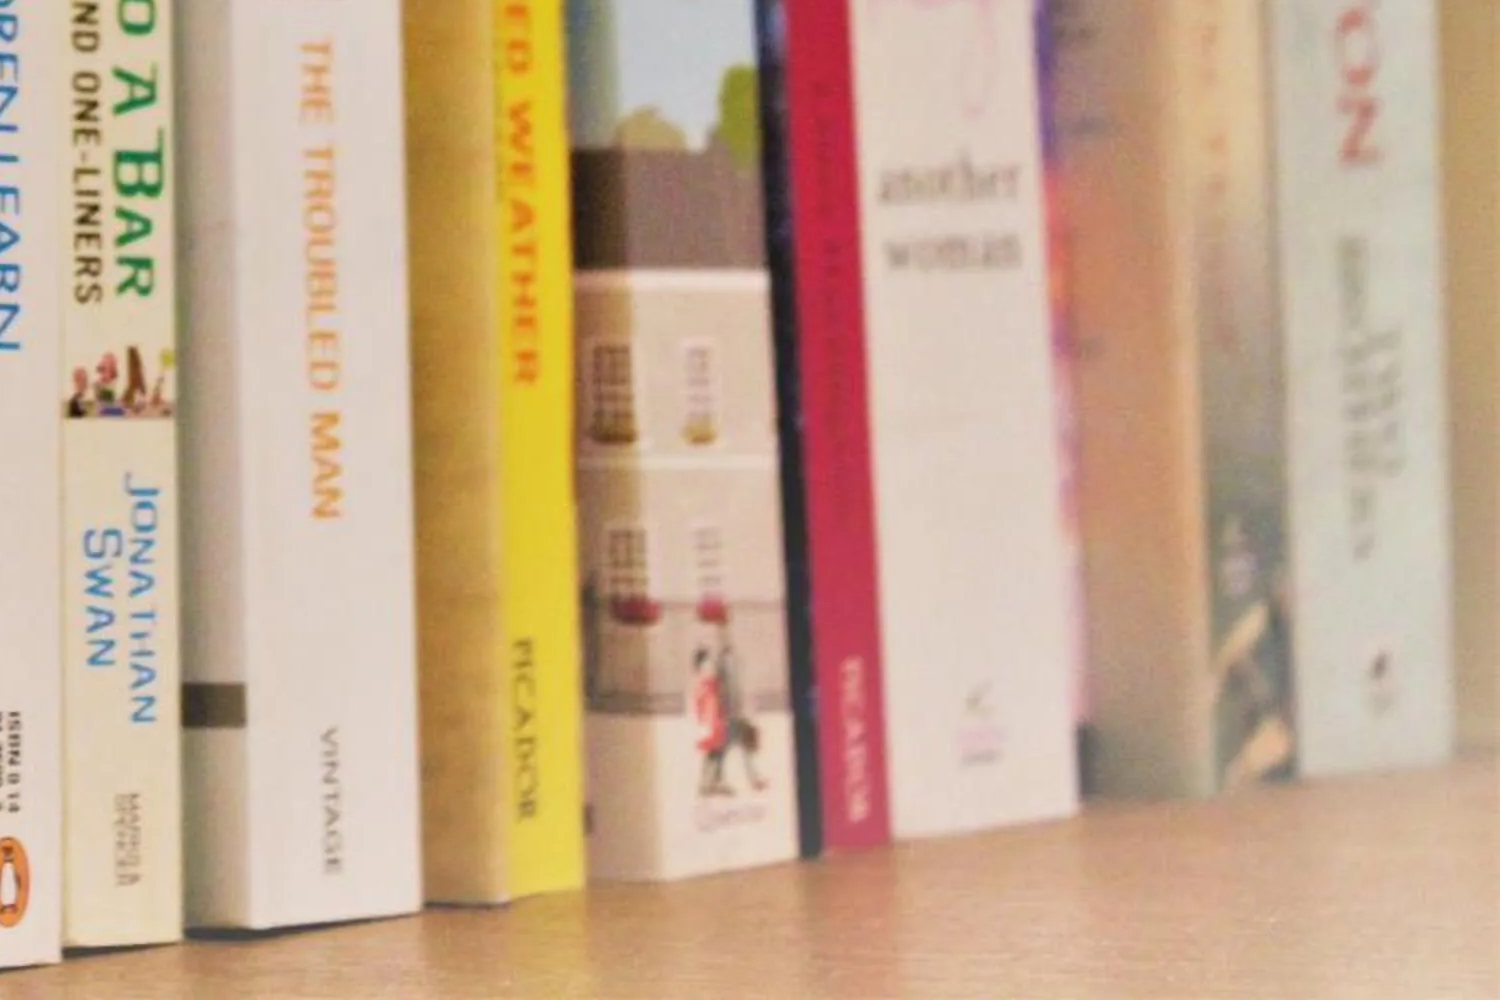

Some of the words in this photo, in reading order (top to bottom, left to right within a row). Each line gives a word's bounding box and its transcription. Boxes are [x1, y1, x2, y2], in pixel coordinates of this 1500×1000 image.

[112, 62, 159, 117] A
[299, 41, 333, 124] THE
[70, 70, 104, 306] ONE-LINERS
[113, 125, 165, 298] BAR
[301, 144, 343, 392] TROUBLED
[507, 100, 541, 387] WEATHER
[309, 409, 344, 521] MAN
[82, 527, 124, 668] SWAN
[124, 472, 160, 725] JONATHAN
[318, 725, 344, 878] VINTAGE
[510, 636, 541, 825] PICADOR
